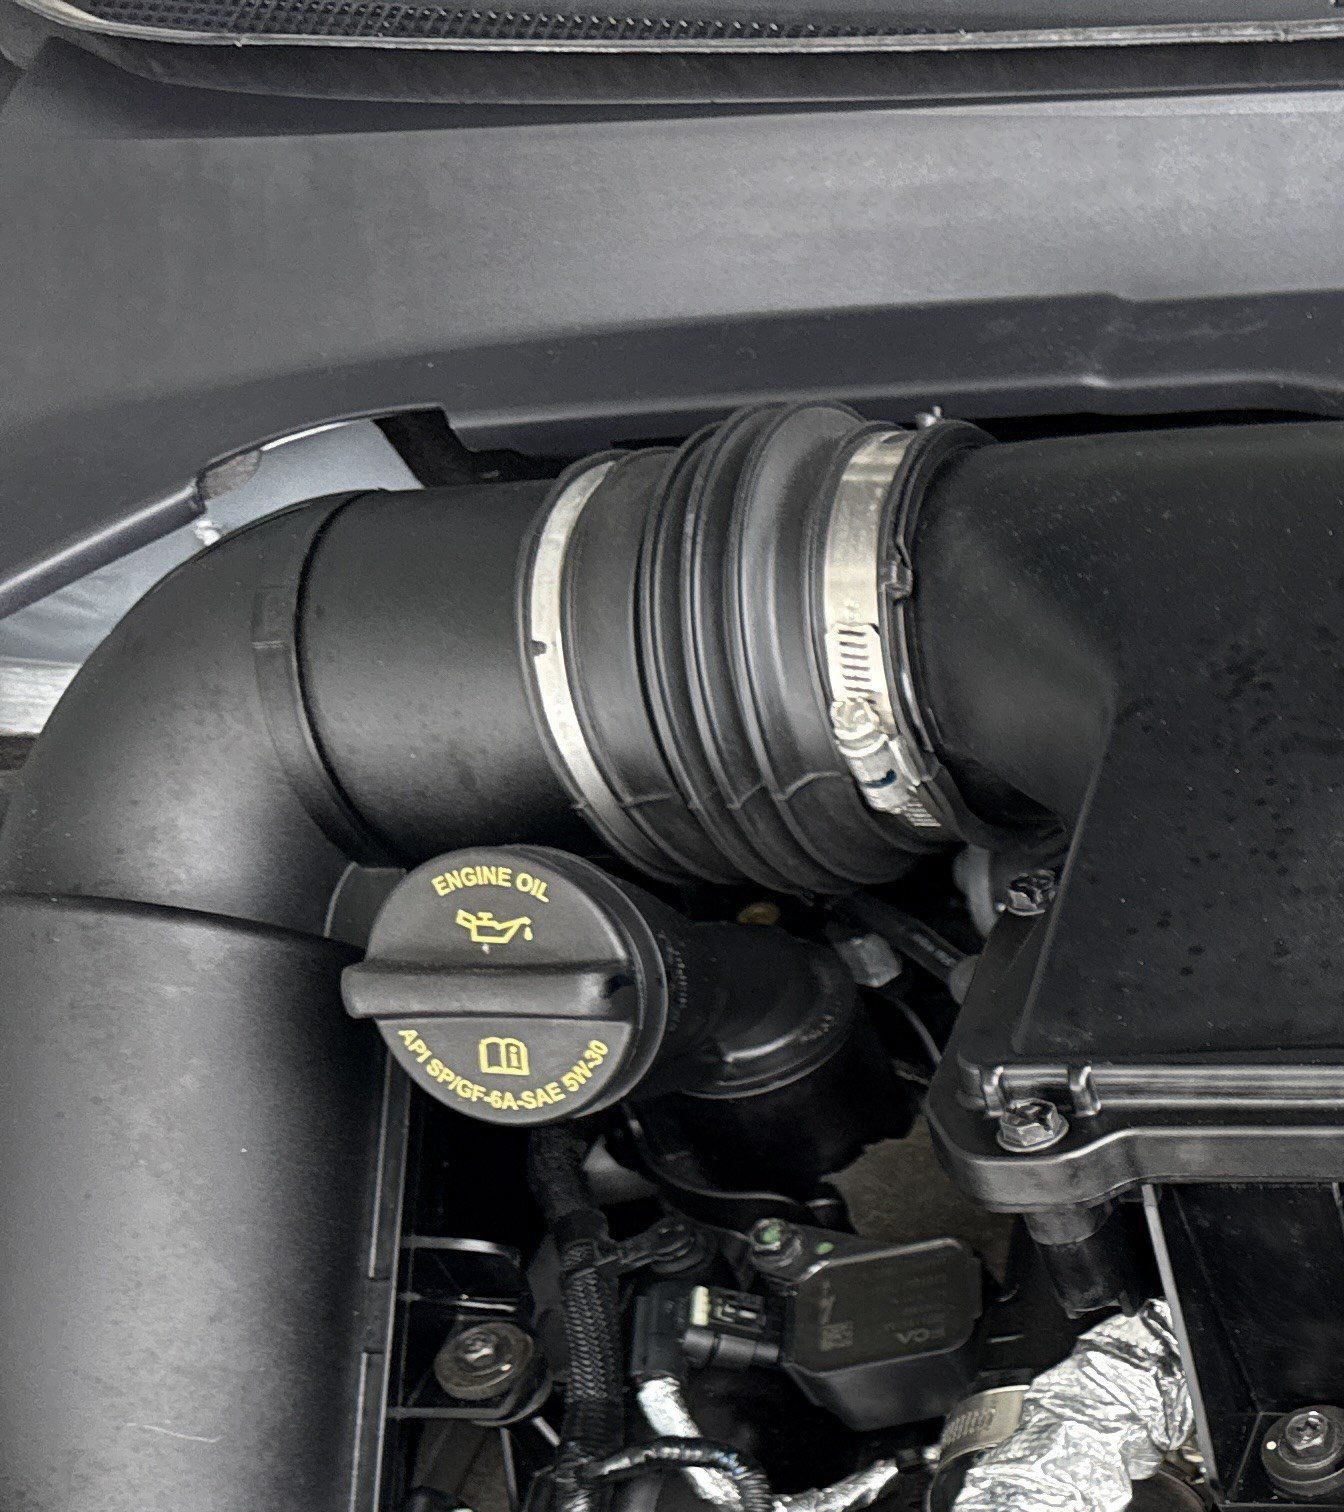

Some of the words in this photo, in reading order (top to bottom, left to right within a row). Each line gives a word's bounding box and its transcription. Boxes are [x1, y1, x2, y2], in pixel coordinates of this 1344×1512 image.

[431, 866, 512, 896] ENGINE
[516, 873, 550, 903] OIL
[398, 1029, 433, 1063] API
[562, 1038, 609, 1093] 5W-30
